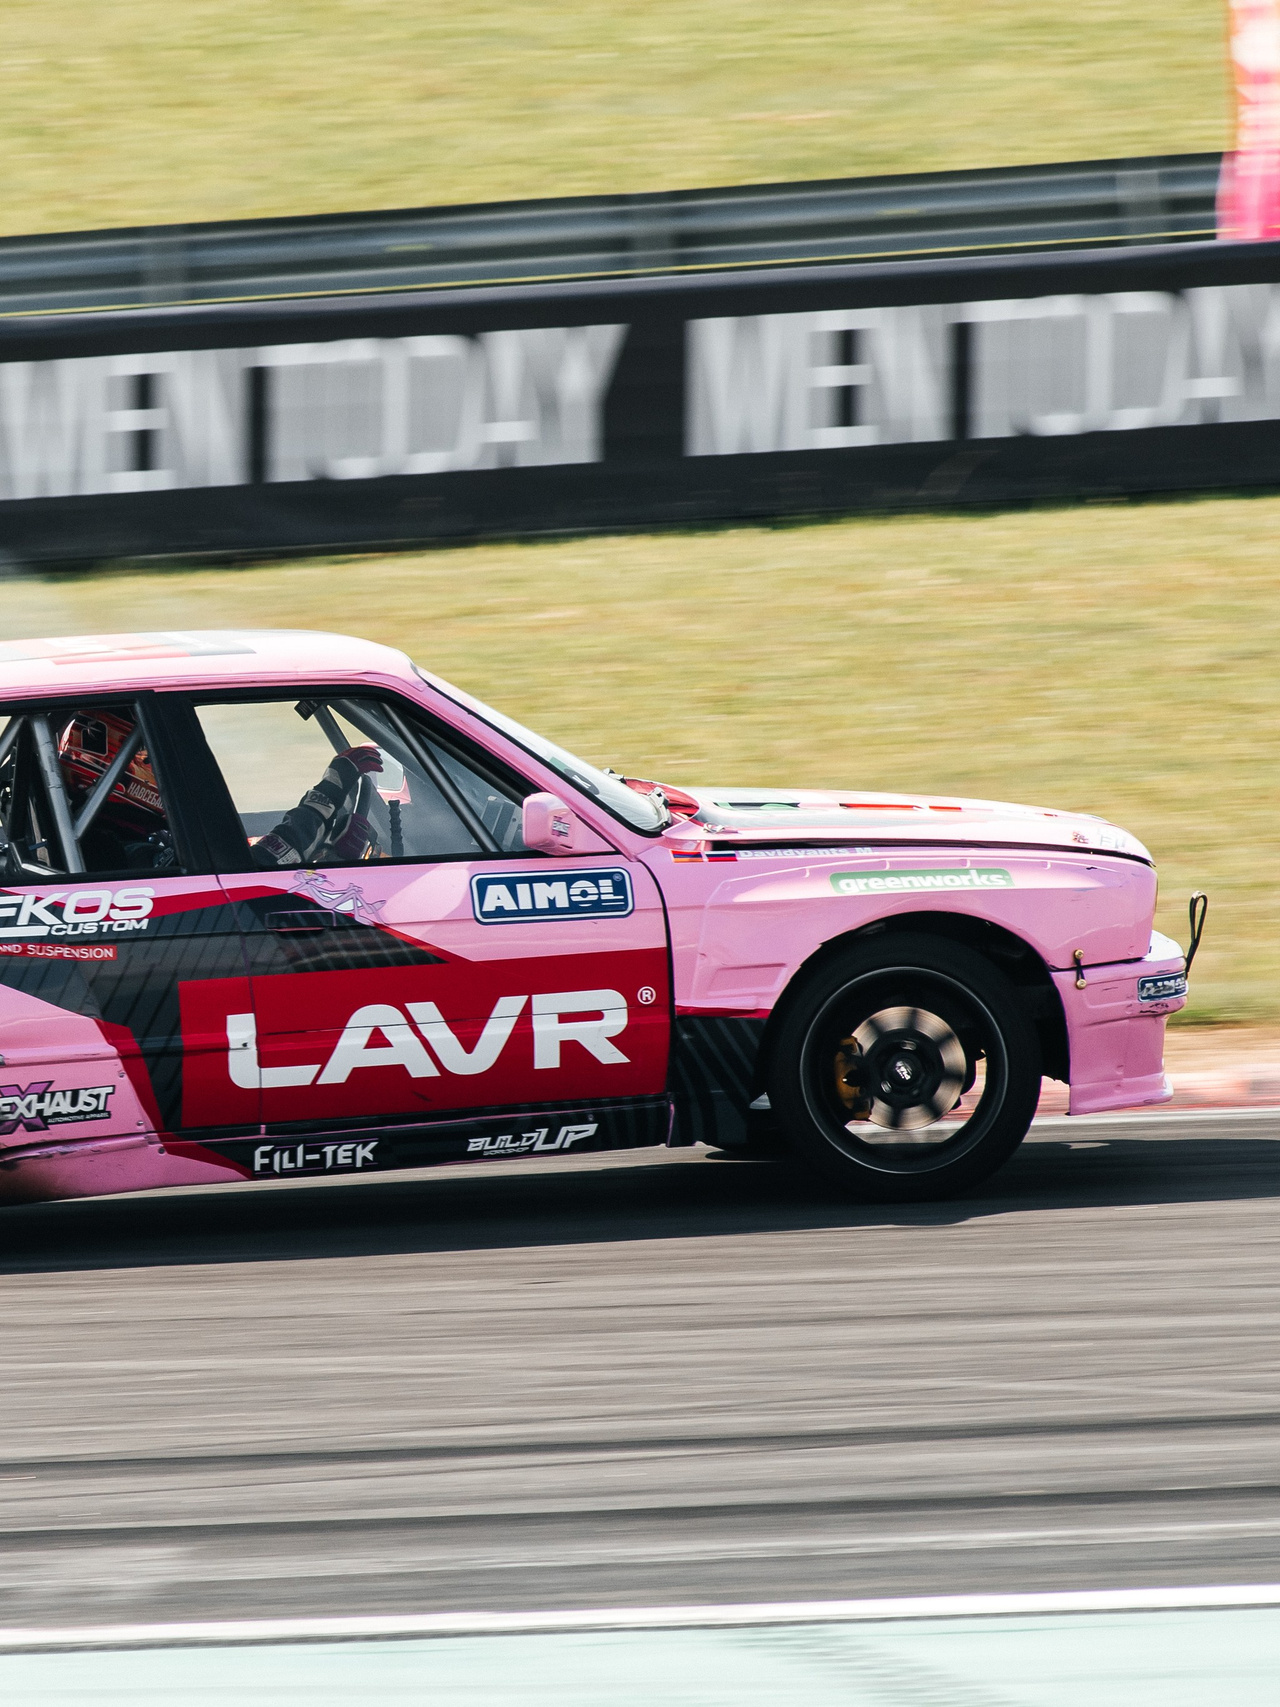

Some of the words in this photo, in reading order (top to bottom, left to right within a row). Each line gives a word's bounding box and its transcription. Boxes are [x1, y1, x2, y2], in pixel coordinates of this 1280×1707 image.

[838, 869, 1007, 893] greenworks
[482, 878, 625, 912] AIMOL
[50, 918, 149, 936] CUSTOM
[26, 943, 114, 959] SUSPENSION
[226, 989, 631, 1089] LAVR
